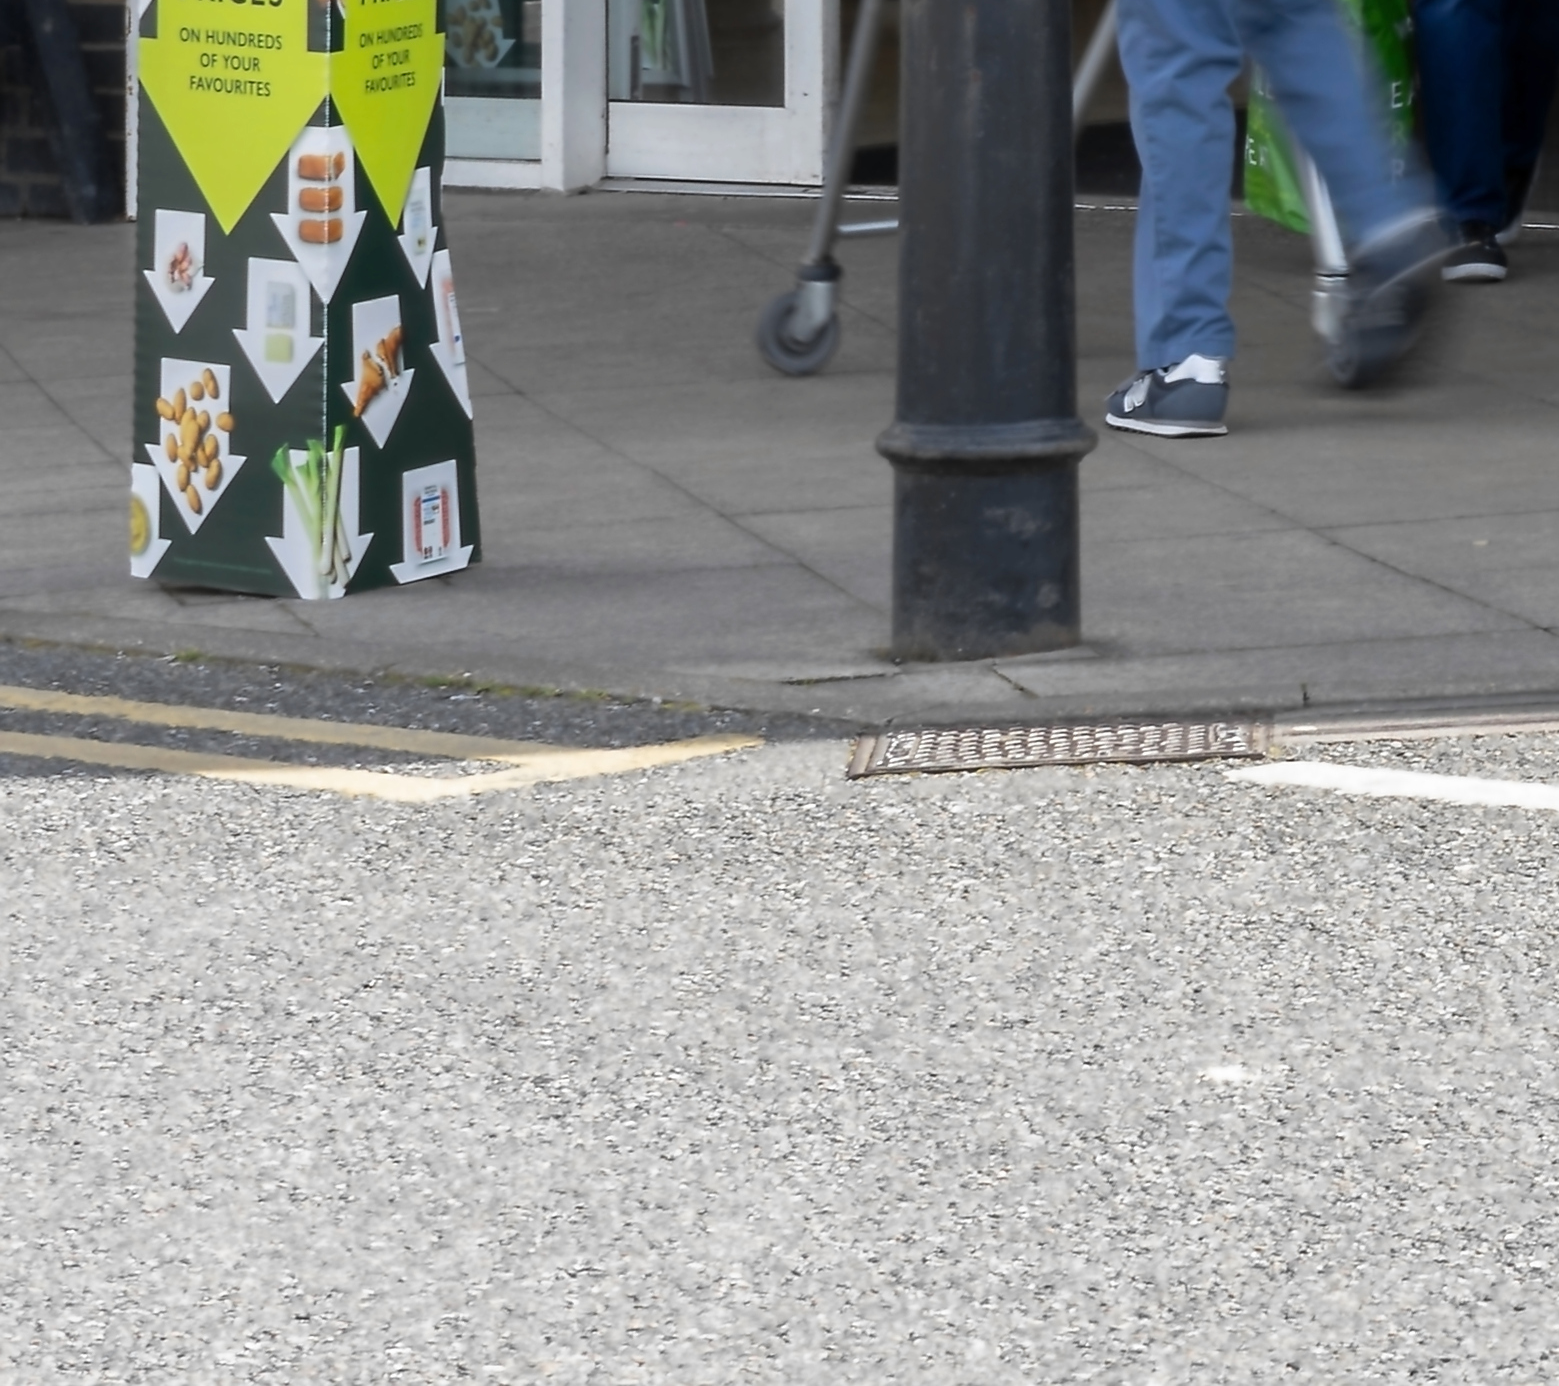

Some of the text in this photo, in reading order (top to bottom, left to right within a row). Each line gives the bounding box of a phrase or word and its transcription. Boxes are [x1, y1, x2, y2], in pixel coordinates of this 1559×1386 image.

[179, 27, 282, 50] ON HUNDREDS
[359, 23, 423, 48] ON HUNDREDS
[200, 53, 260, 72] OF YOUR
[372, 49, 410, 70] OF YOUR
[190, 76, 271, 97] FAVOURITES
[365, 71, 416, 94] FAVOURITES
